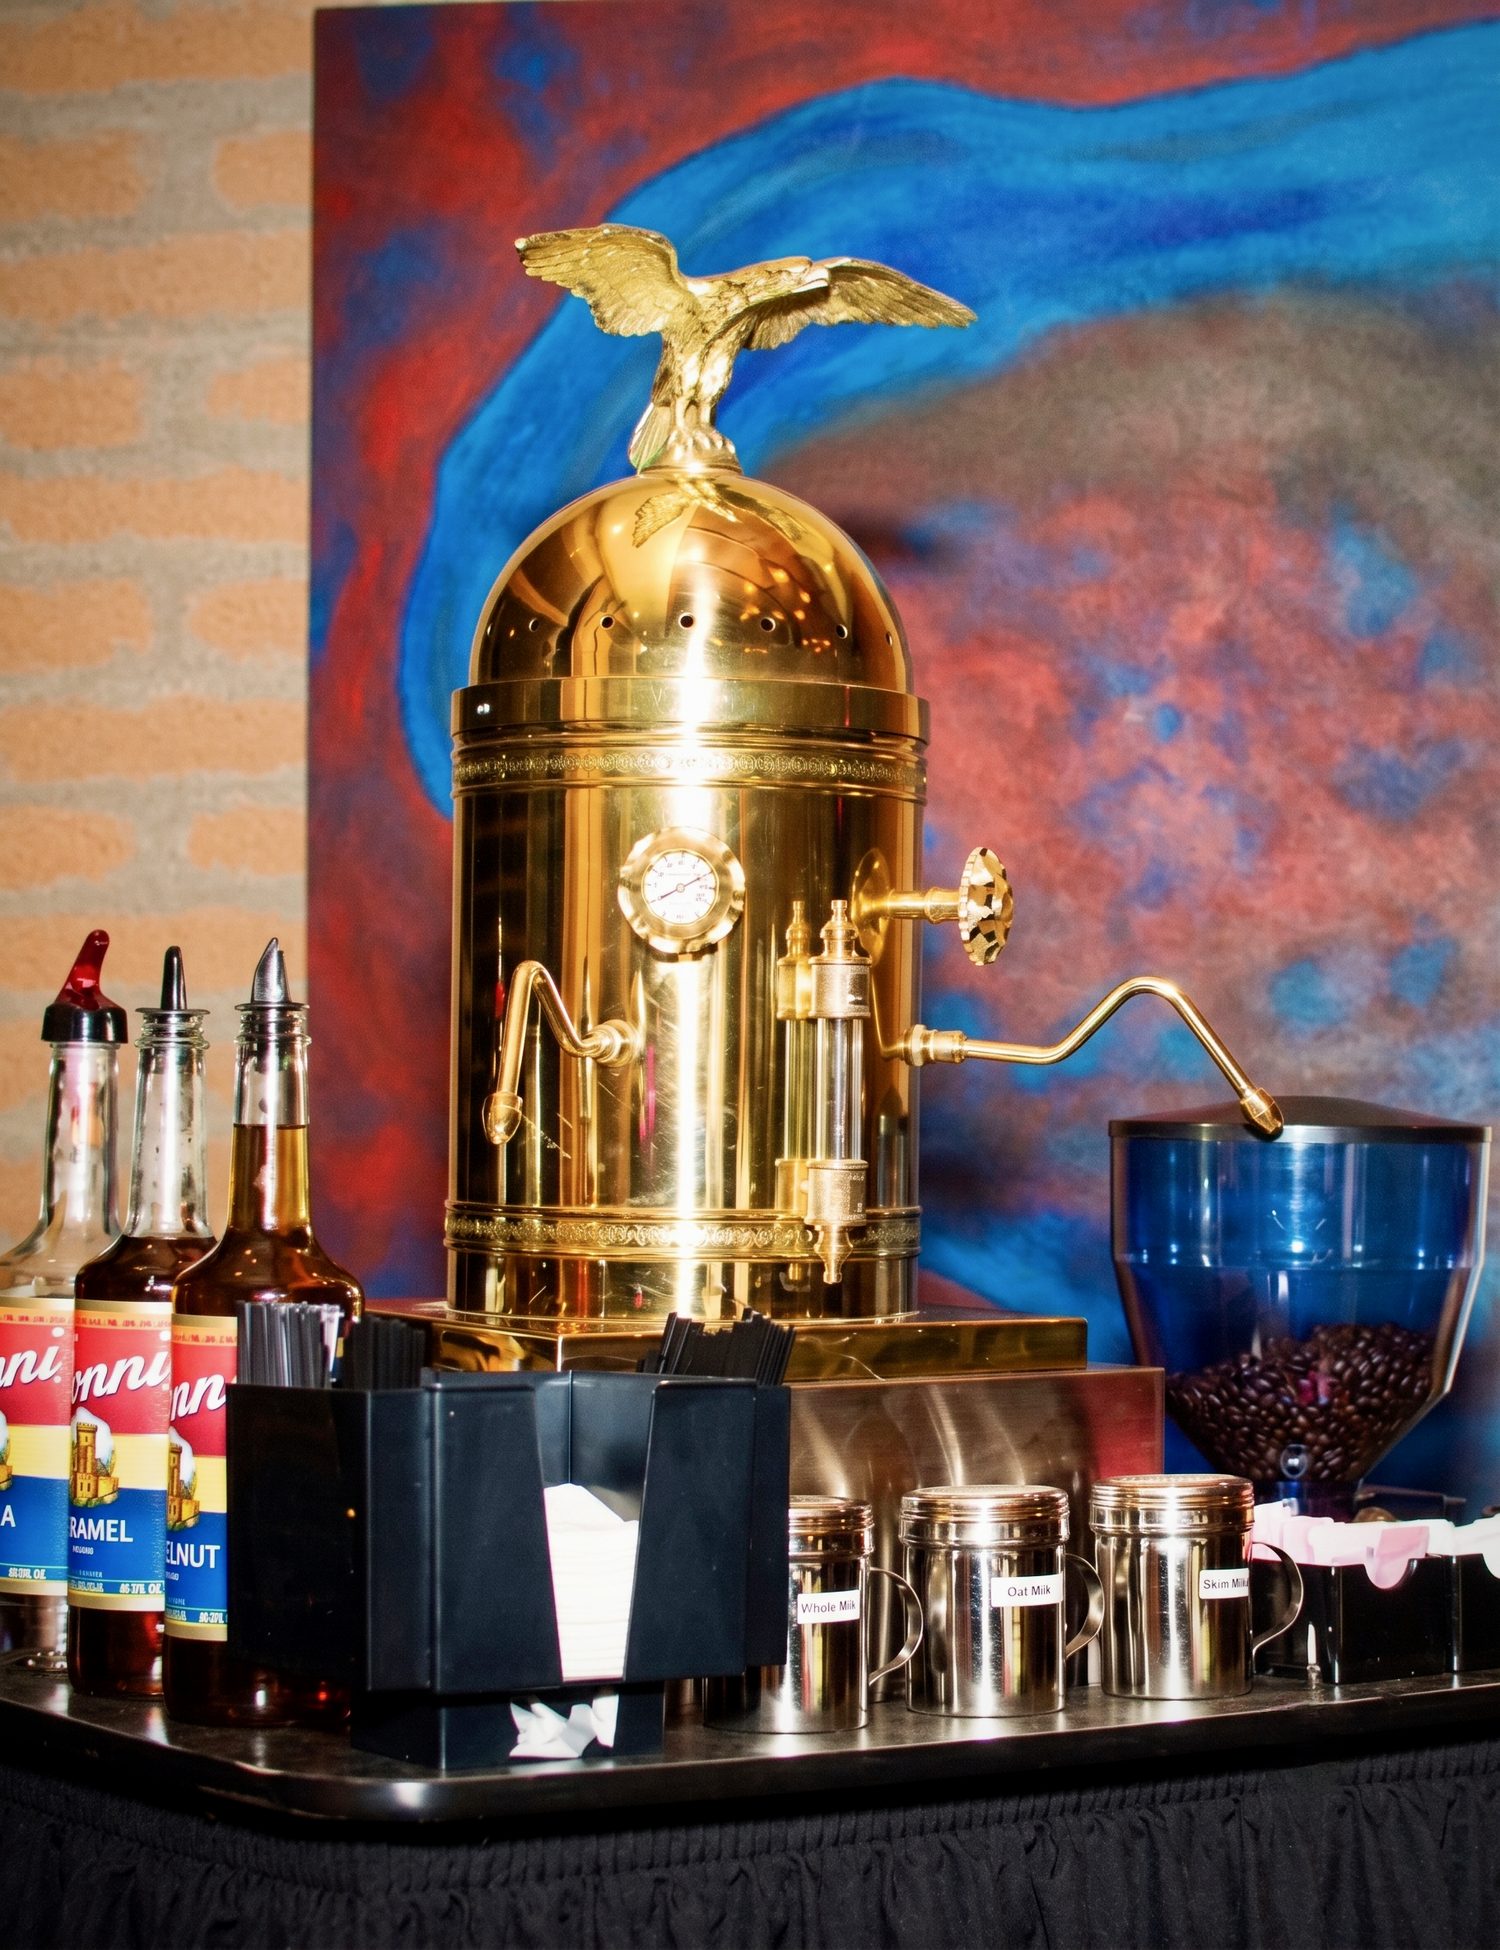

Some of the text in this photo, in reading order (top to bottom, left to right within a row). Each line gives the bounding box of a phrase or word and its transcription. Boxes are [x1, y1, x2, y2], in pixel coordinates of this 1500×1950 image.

[169, 1373, 237, 1422] nn
[69, 1516, 134, 1543] RAMEL
[1203, 1579, 1229, 1590] Skim
[1007, 1586, 1028, 1597] Oat
[801, 1602, 836, 1614] Whole
